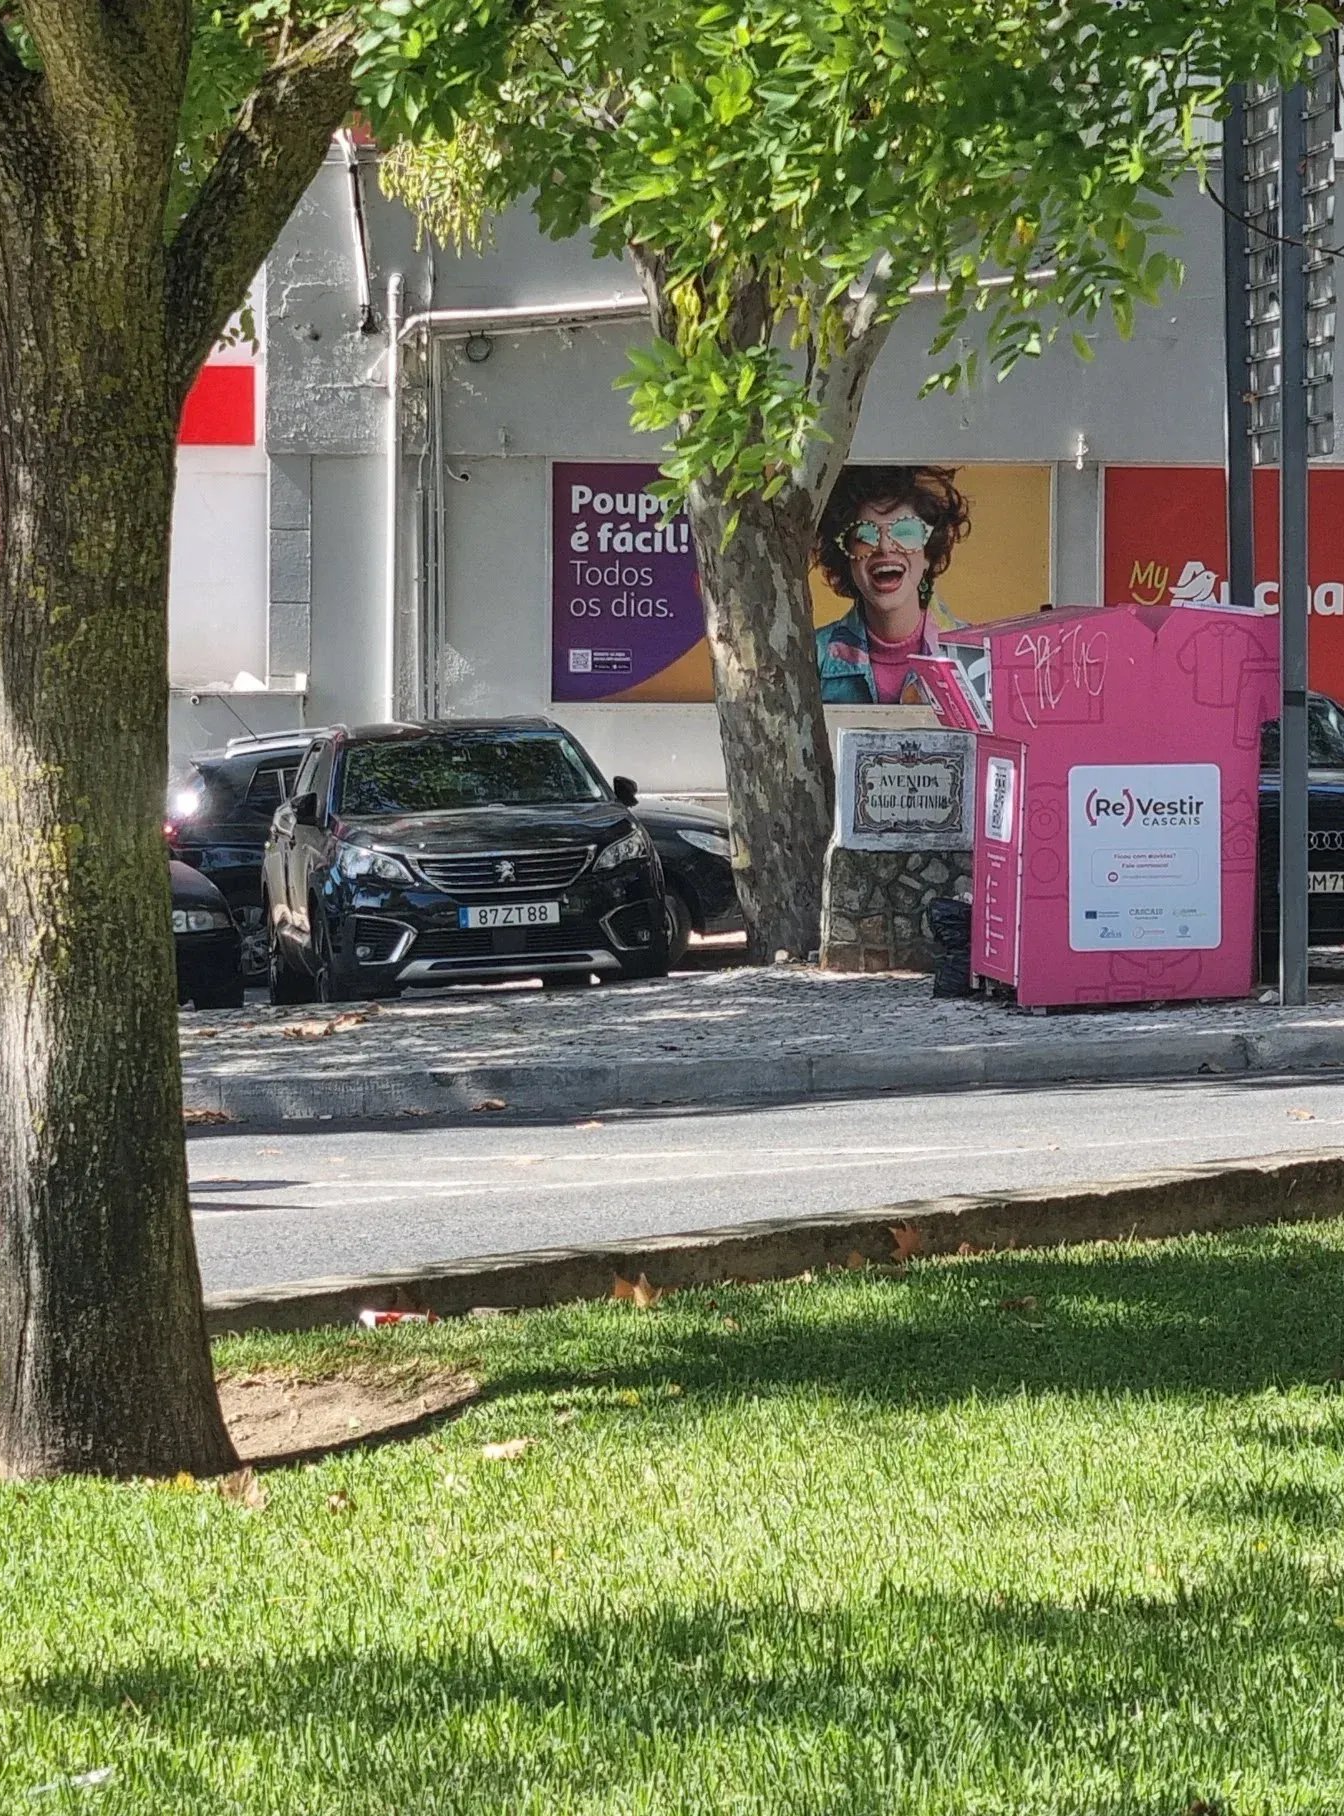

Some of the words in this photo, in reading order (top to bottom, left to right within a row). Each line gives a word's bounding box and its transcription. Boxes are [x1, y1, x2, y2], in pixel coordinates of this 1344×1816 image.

[570, 485, 689, 523] Poupa
[570, 521, 590, 553] é
[597, 521, 689, 554] fácil!
[569, 560, 654, 587] Todos
[1129, 560, 1169, 606] My
[570, 598, 602, 617] os
[611, 591, 674, 618] dias.
[880, 775, 940, 788] AVENIDA
[1142, 816, 1201, 826] CASCAIS
[478, 905, 549, 925] 87ZT88
